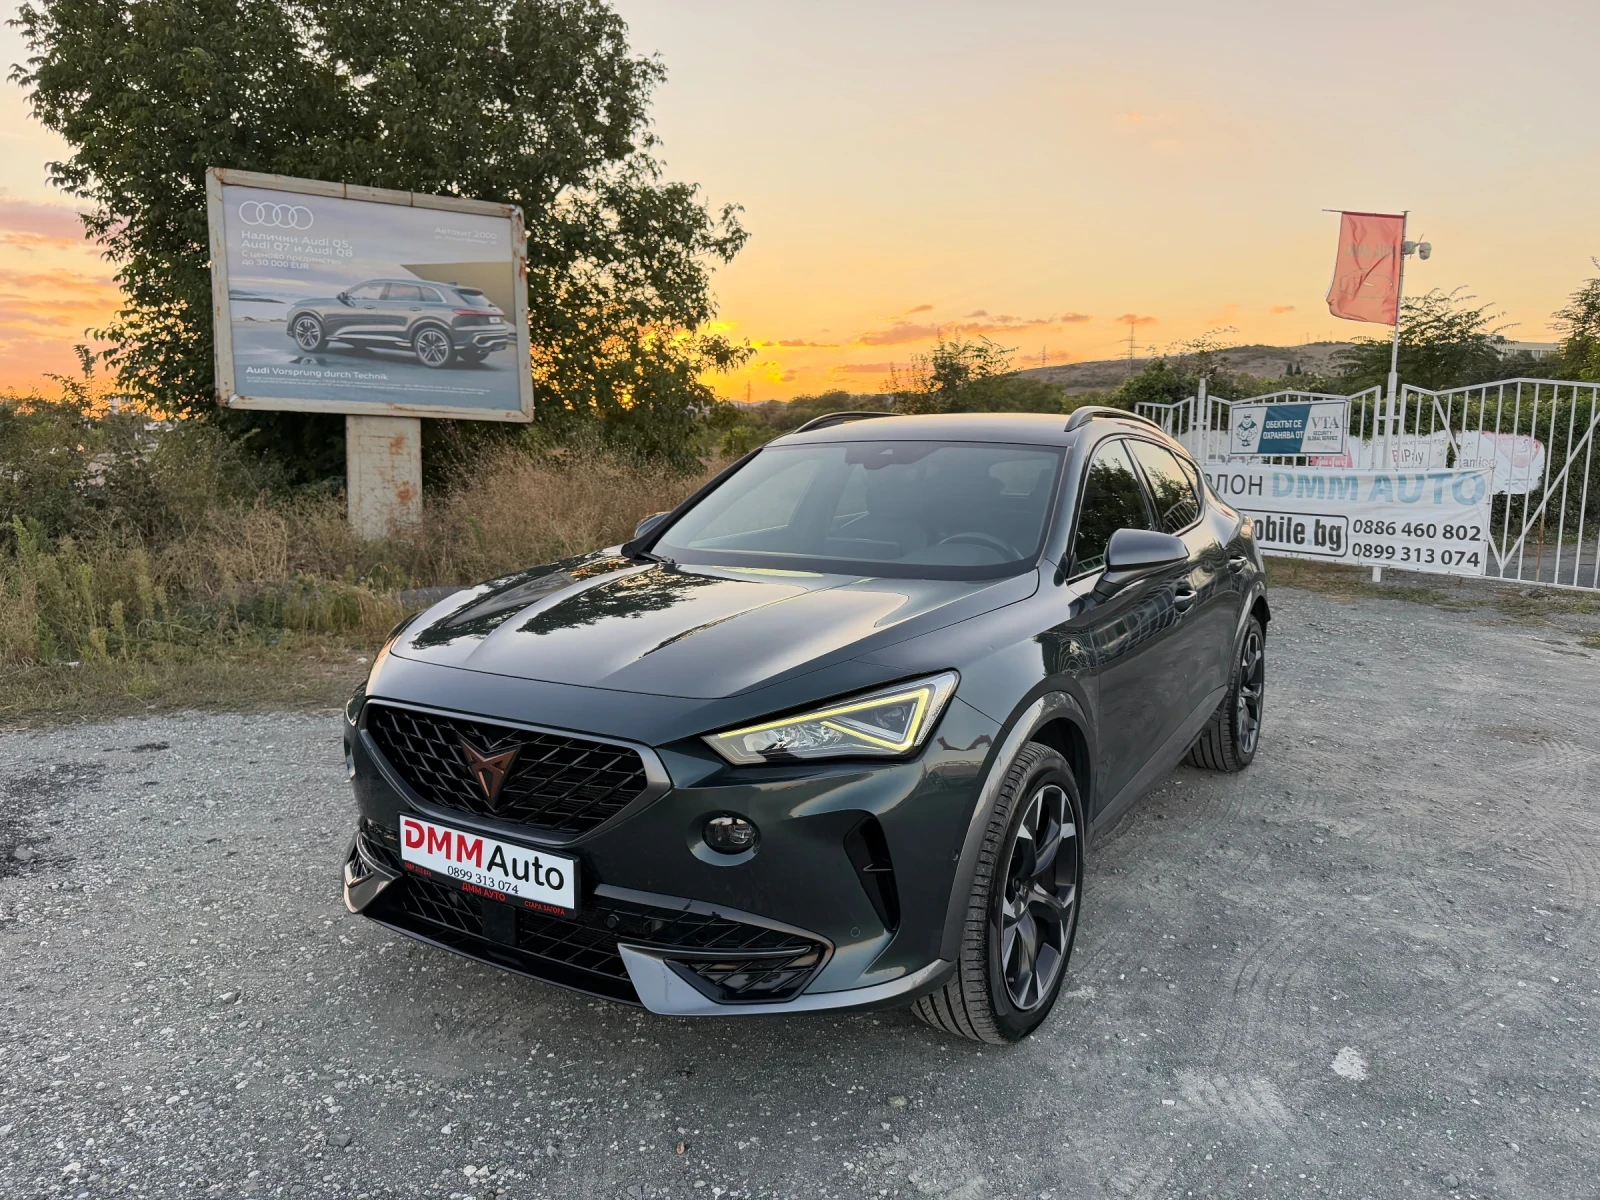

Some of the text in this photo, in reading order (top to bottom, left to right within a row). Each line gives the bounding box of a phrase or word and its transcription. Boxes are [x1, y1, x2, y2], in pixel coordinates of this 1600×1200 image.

[241, 230, 298, 243] Налични
[301, 236, 329, 247] Audi
[473, 230, 497, 240] 2000
[241, 239, 270, 249] Audi
[273, 241, 290, 251] Q7
[305, 245, 333, 255] Audi
[336, 247, 353, 257] Q8
[270, 260, 289, 268] 000
[290, 261, 310, 270] EUR
[246, 366, 389, 381] Audi Vorsprung durch Technik
[1265, 419, 1303, 429] ОБЕКТЪТ СЕ
[1310, 415, 1340, 429] VTA
[1262, 430, 1304, 440] ОХРАНЯВА ОТ
[1271, 472, 1359, 501] DMM
[1368, 471, 1486, 505] AUTO
[1254, 515, 1342, 552] obile.bg
[1353, 519, 1481, 541] 0886 460 802
[1352, 543, 1480, 567] 0899 313 074
[447, 865, 519, 894] 0899 313 074
[461, 881, 506, 902] ДММ АУТО
[524, 900, 566, 915] СТАРА ЗАГОРА
